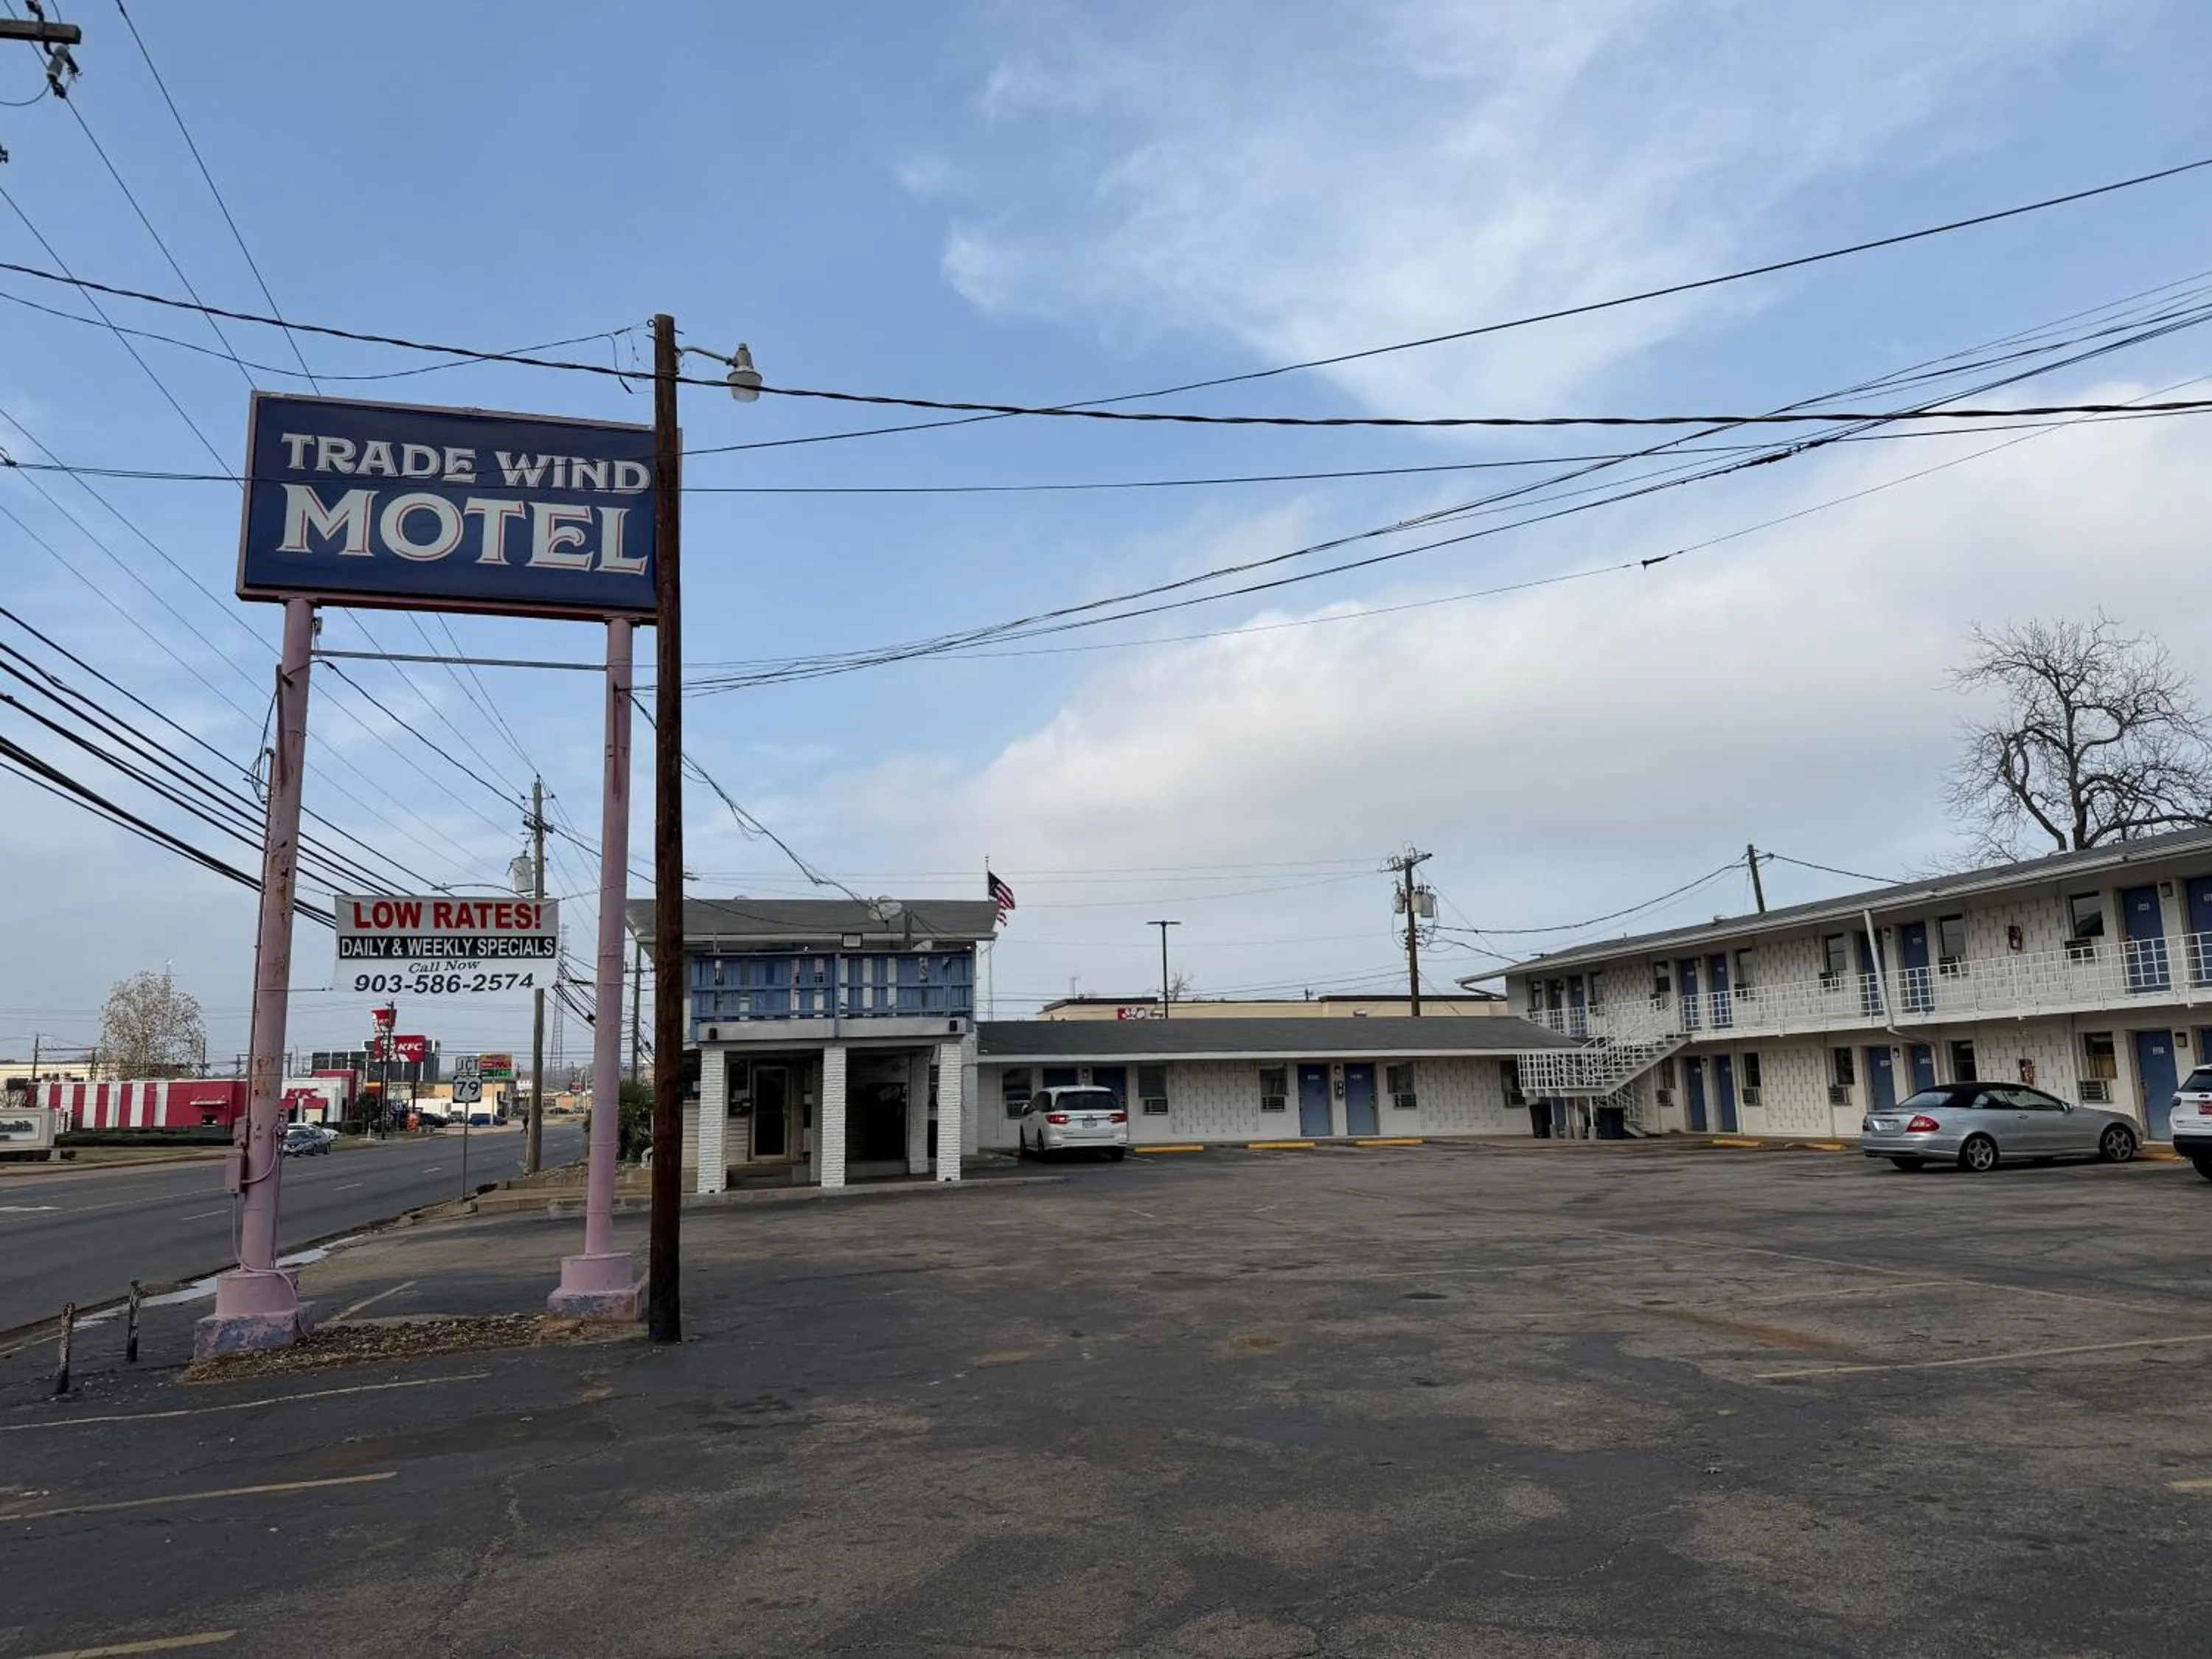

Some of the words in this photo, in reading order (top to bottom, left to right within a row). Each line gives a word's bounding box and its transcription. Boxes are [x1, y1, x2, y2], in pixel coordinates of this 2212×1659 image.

[281, 433, 477, 483] TRADE
[495, 450, 651, 495] WIND
[276, 483, 649, 575] MOTEL
[353, 901, 422, 929] LOW
[433, 901, 542, 930] RATES!
[341, 938, 387, 956] DAILY
[392, 939, 403, 956] &
[408, 938, 473, 956] WEEKLY
[477, 937, 554, 957] SPECIALS
[408, 961, 440, 974] Call
[444, 960, 481, 972] Now
[354, 973, 535, 994] 903-586-2574
[397, 1042, 423, 1051] KFC
[458, 1059, 479, 1071] JCT
[456, 1082, 479, 1096] 79
